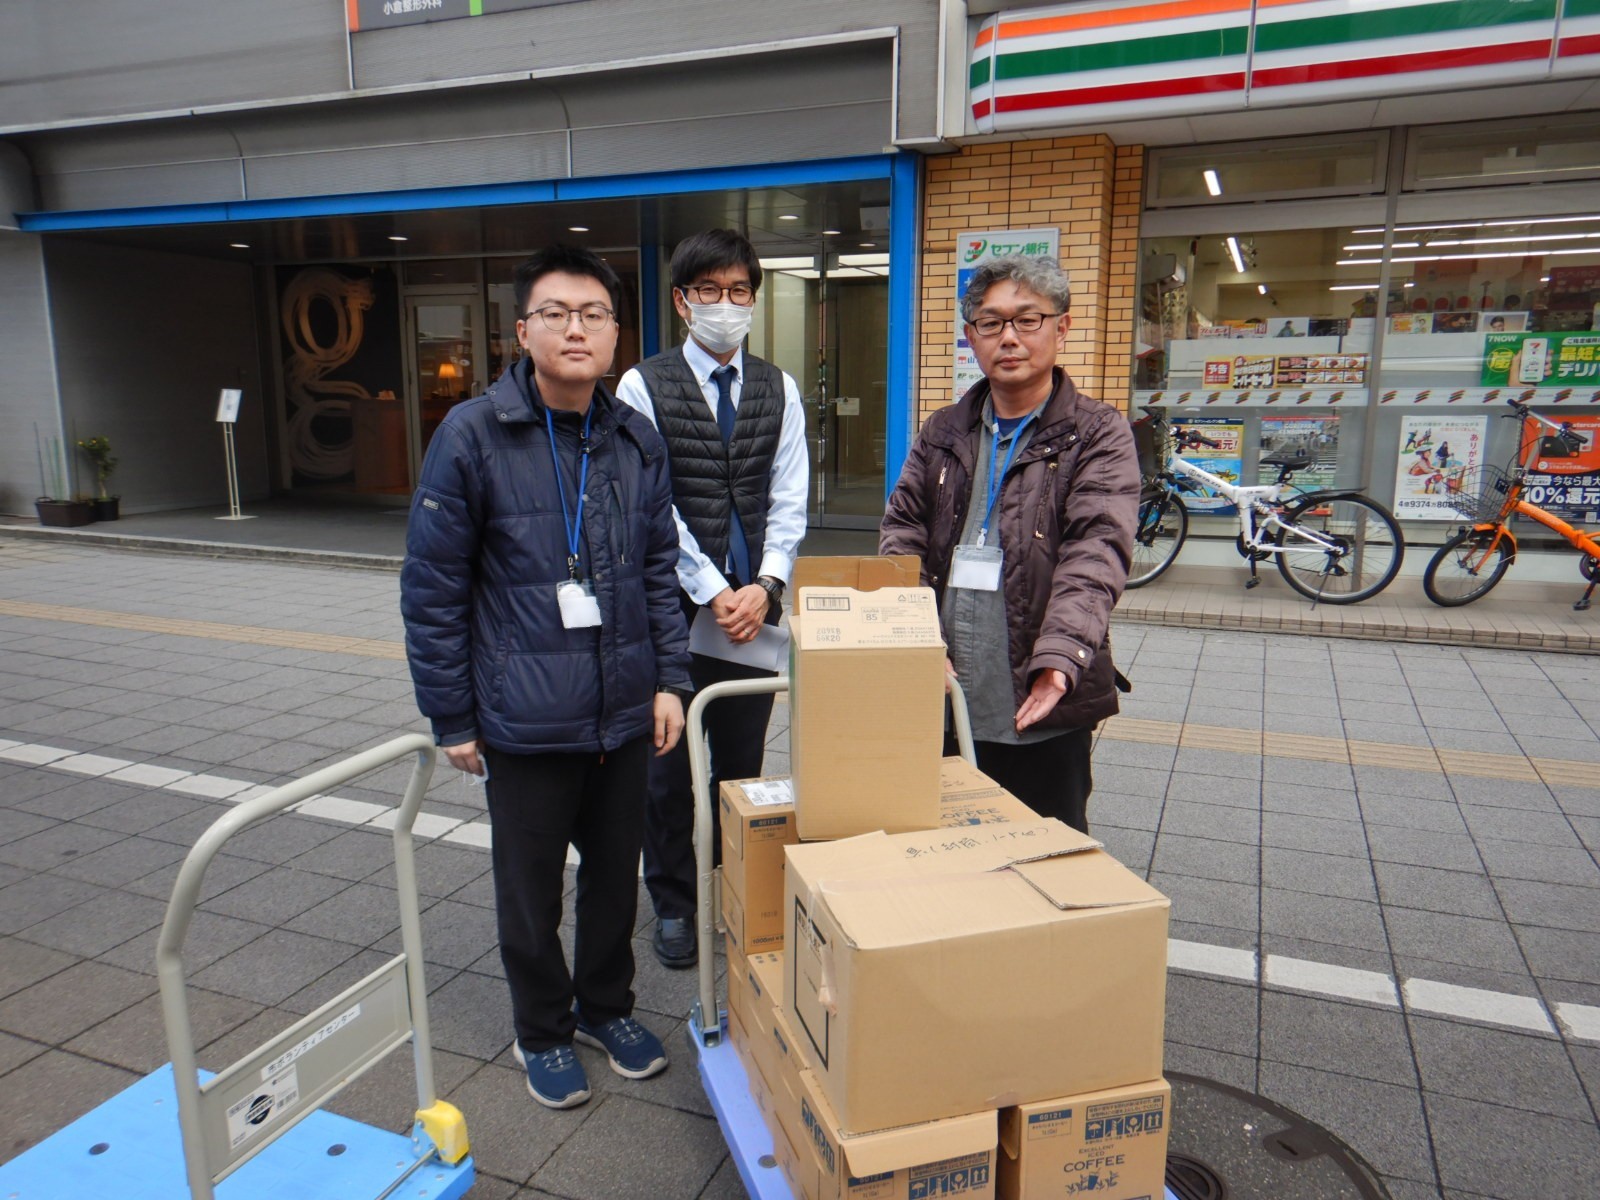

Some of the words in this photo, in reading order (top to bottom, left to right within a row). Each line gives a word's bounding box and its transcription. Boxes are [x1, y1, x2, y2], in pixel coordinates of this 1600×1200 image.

[991, 242, 1049, 257] セブン銀行
[1208, 364, 1228, 374] 予告
[1553, 474, 1600, 487] 今なら最大
[1079, 1144, 1114, 1155] EXCELLENT
[1063, 1154, 1125, 1173] COFFEE
